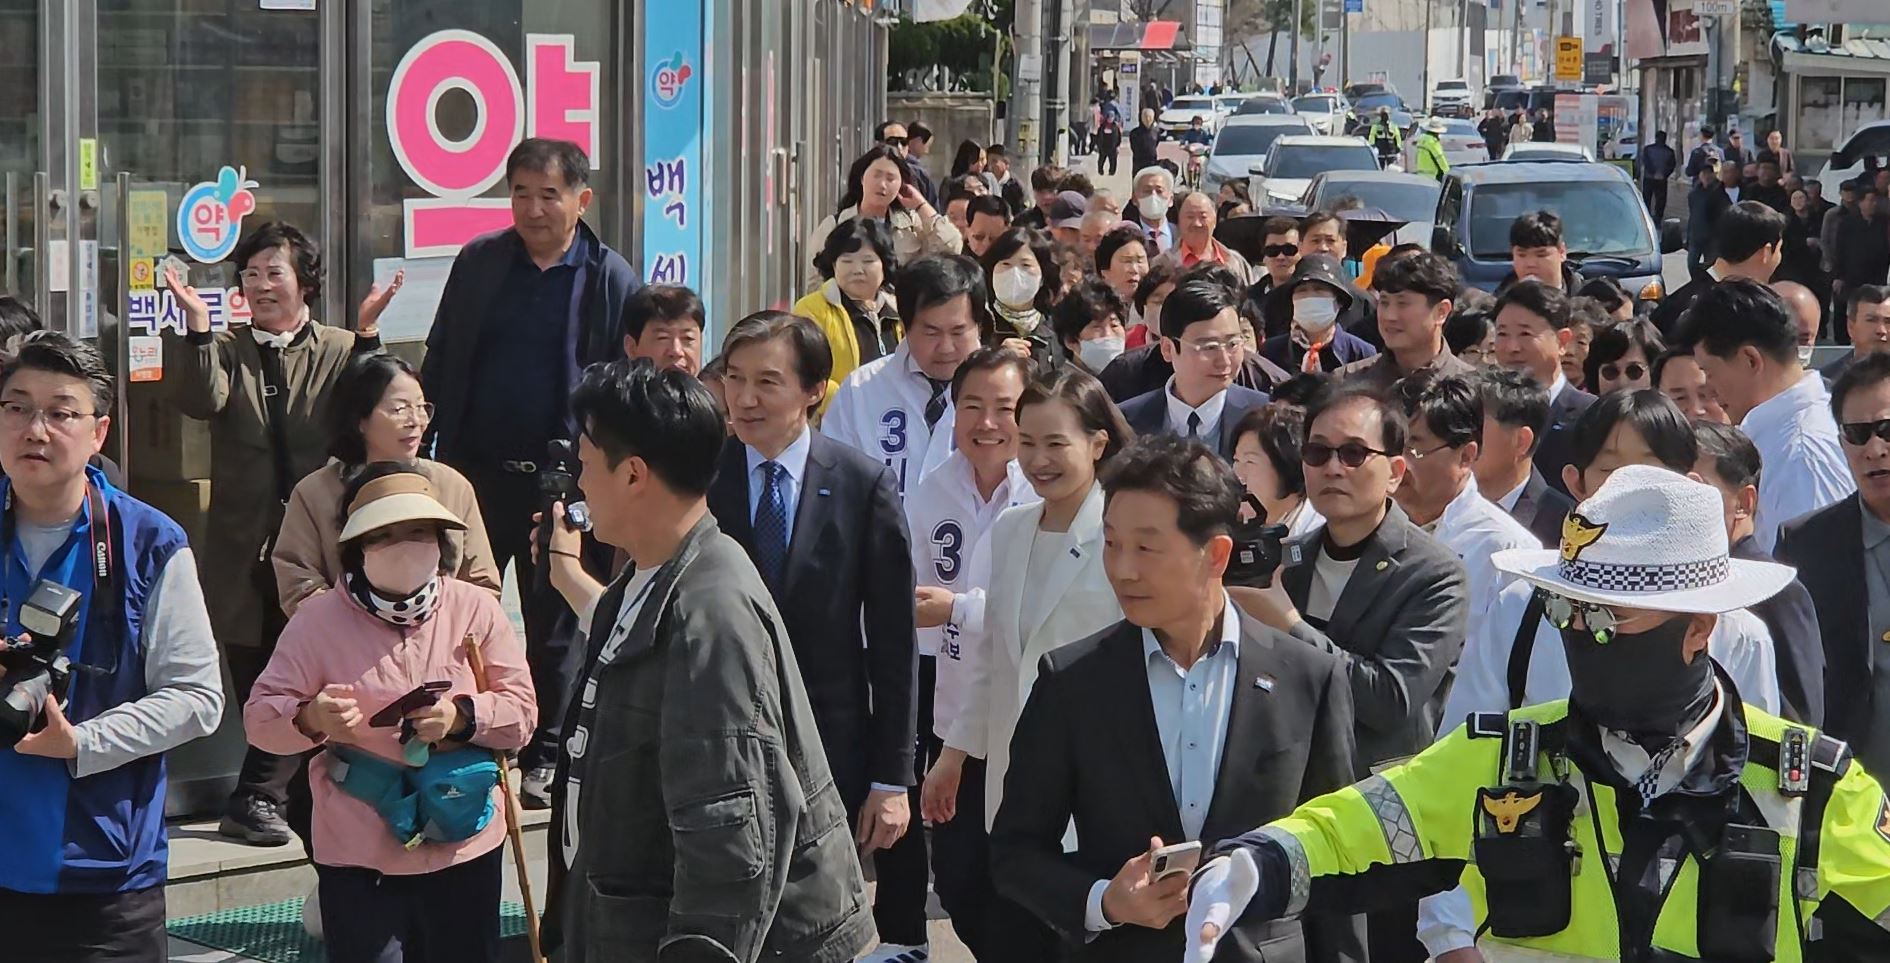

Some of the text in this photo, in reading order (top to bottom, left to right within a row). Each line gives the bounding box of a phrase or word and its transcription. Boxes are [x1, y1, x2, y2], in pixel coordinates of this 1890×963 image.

[1701, 2, 1727, 12] 100m
[659, 70, 677, 96] 약
[194, 203, 225, 242] 약
[880, 409, 907, 453] 3
[96, 541, 107, 577] Canon
[933, 520, 963, 582] 3
